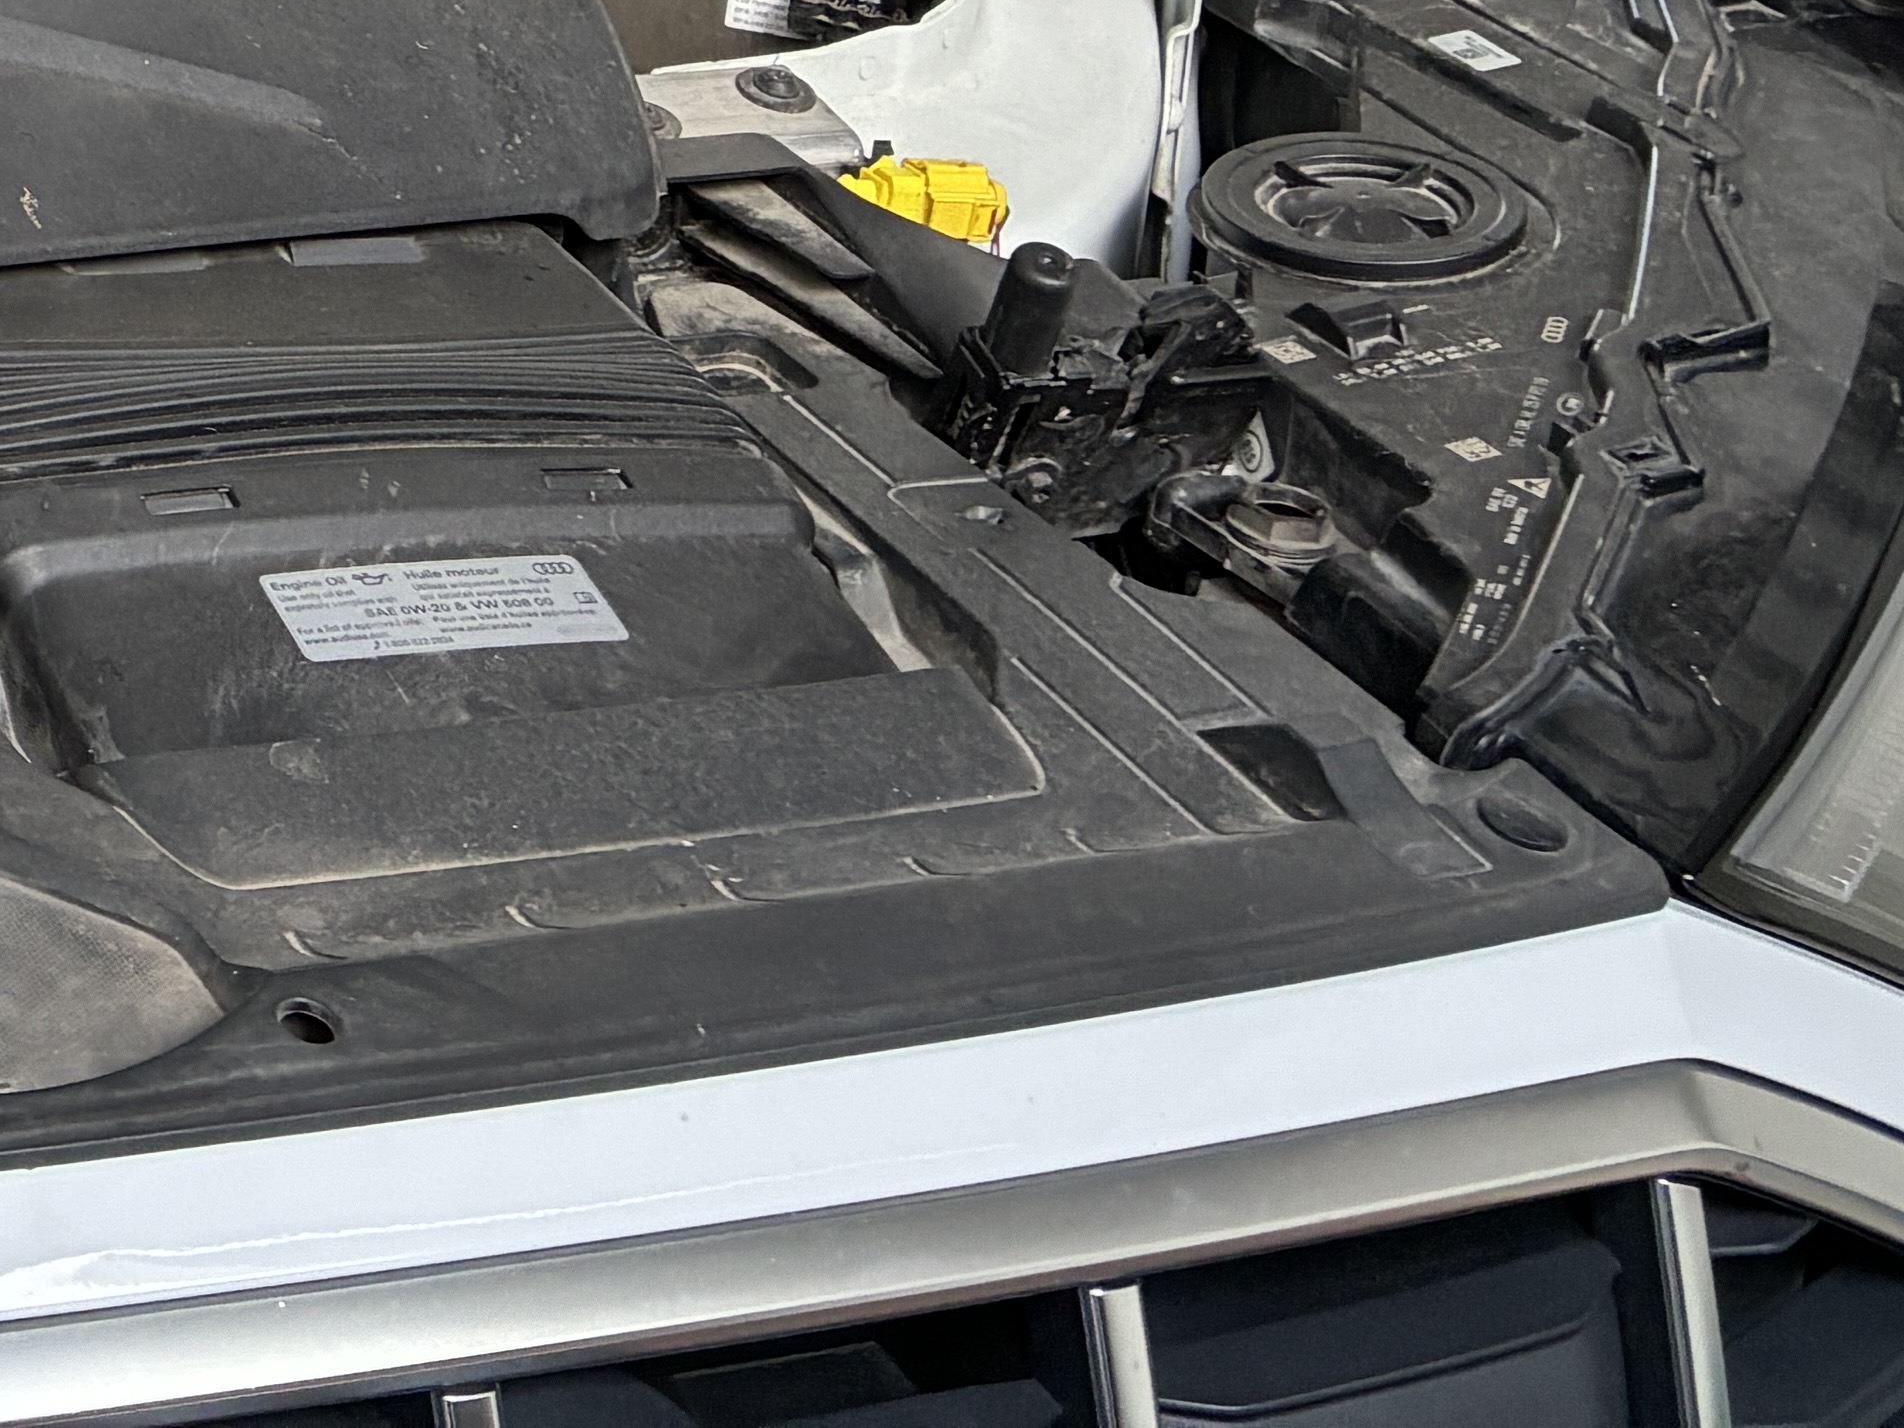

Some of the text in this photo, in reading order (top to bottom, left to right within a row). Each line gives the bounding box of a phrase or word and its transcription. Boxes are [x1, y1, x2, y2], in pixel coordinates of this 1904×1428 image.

[403, 566, 498, 581] Huile moteur
[269, 575, 346, 593] Engine Oil
[364, 605, 395, 617] SAE
[400, 603, 448, 615] 0W-20
[455, 601, 466, 611] &
[469, 599, 497, 609] VW
[534, 596, 554, 606] 00
